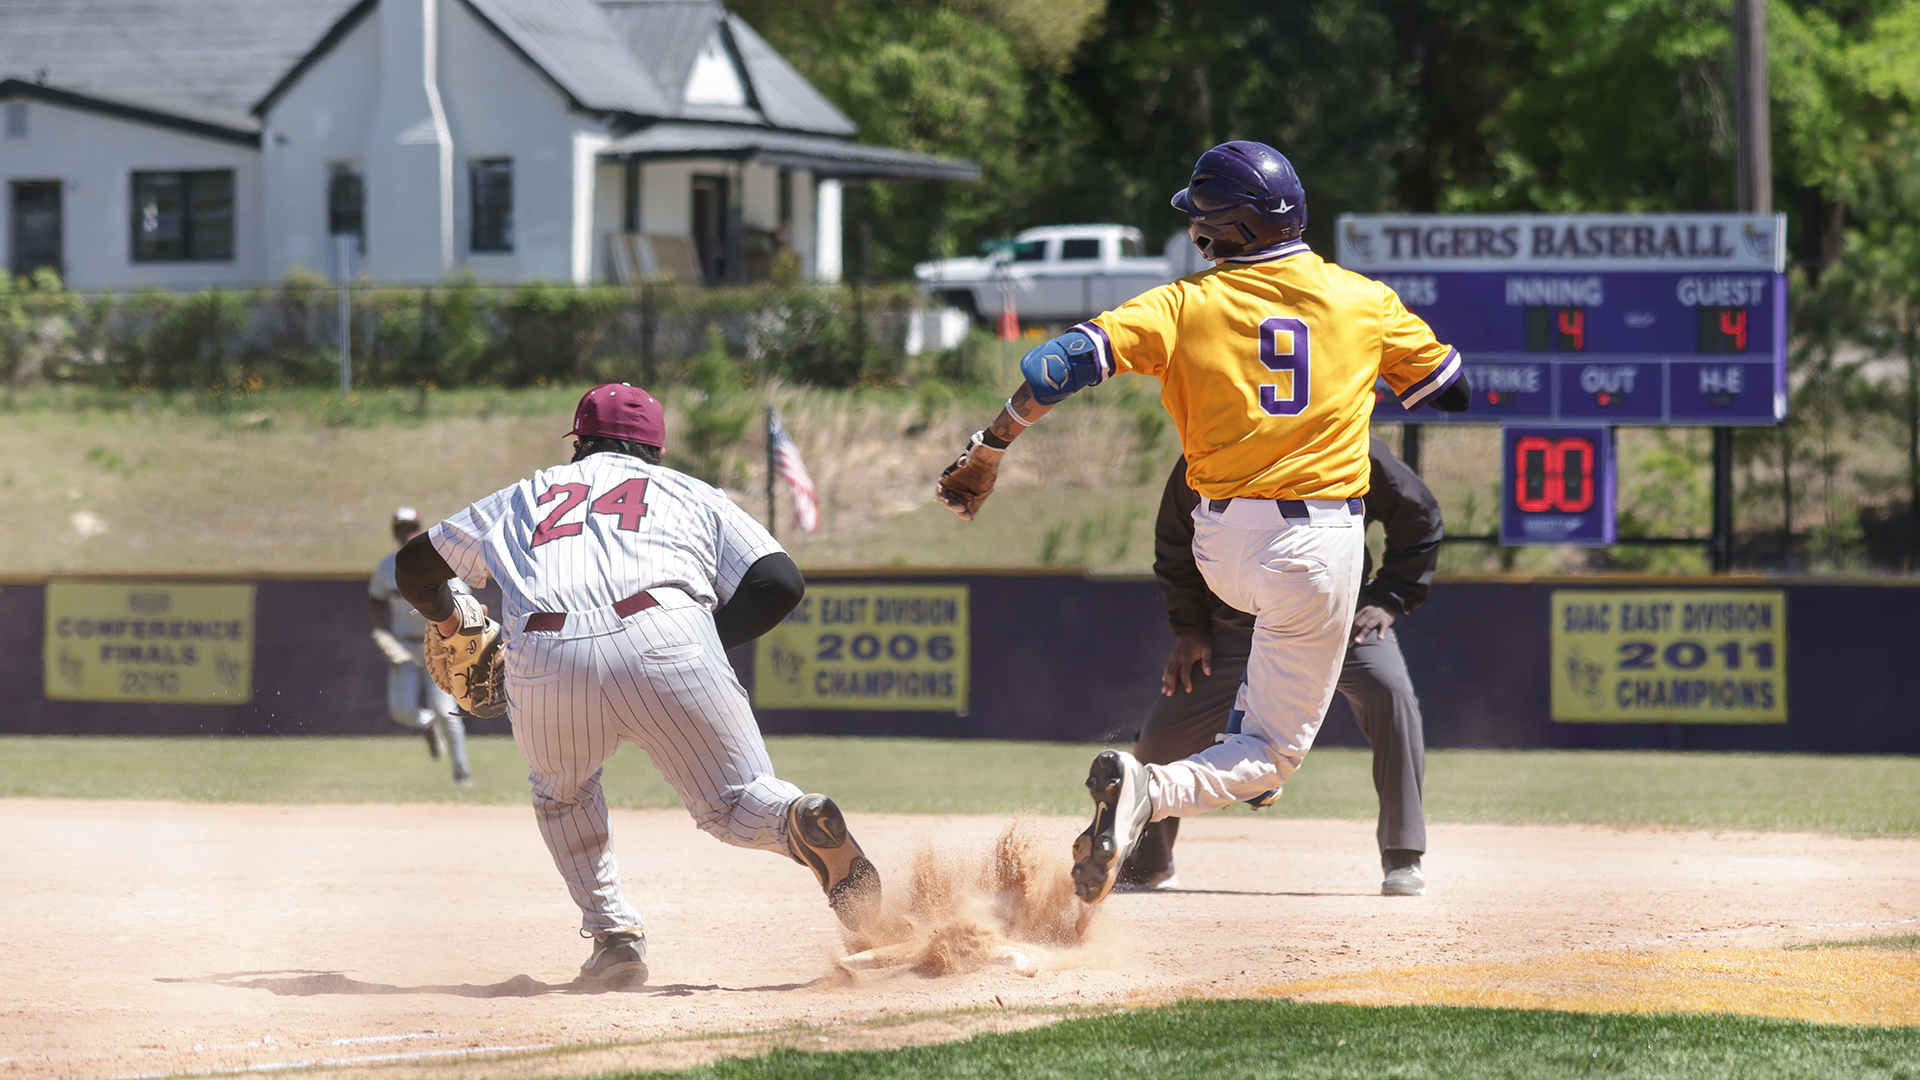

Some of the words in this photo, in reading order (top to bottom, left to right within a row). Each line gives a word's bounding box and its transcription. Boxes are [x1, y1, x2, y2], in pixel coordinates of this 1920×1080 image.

[1383, 226, 1518, 260] TIGERS
[1531, 225, 1733, 260] BASEBALL
[1383, 276, 1438, 306] ERS
[1505, 276, 1604, 307] INNING
[1676, 276, 1767, 307] GUEST
[1558, 307, 1585, 351] 4
[1719, 307, 1747, 351] 4
[1258, 316, 1310, 417] 9
[1580, 365, 1639, 394] OUT
[1515, 436, 1594, 513] 00
[529, 478, 649, 550] 24
[820, 596, 868, 626] EAST
[872, 596, 957, 626] DIVISION
[1620, 602, 1674, 635] EAST
[1681, 602, 1774, 635] DIVISION
[56, 617, 242, 642] CONFERENCE
[100, 644, 200, 667] FINALS
[815, 633, 956, 663] 2006
[1616, 641, 1775, 672] 2011
[814, 669, 957, 698] CHAMPIONS
[1616, 677, 1776, 711] CHAMPIONS
